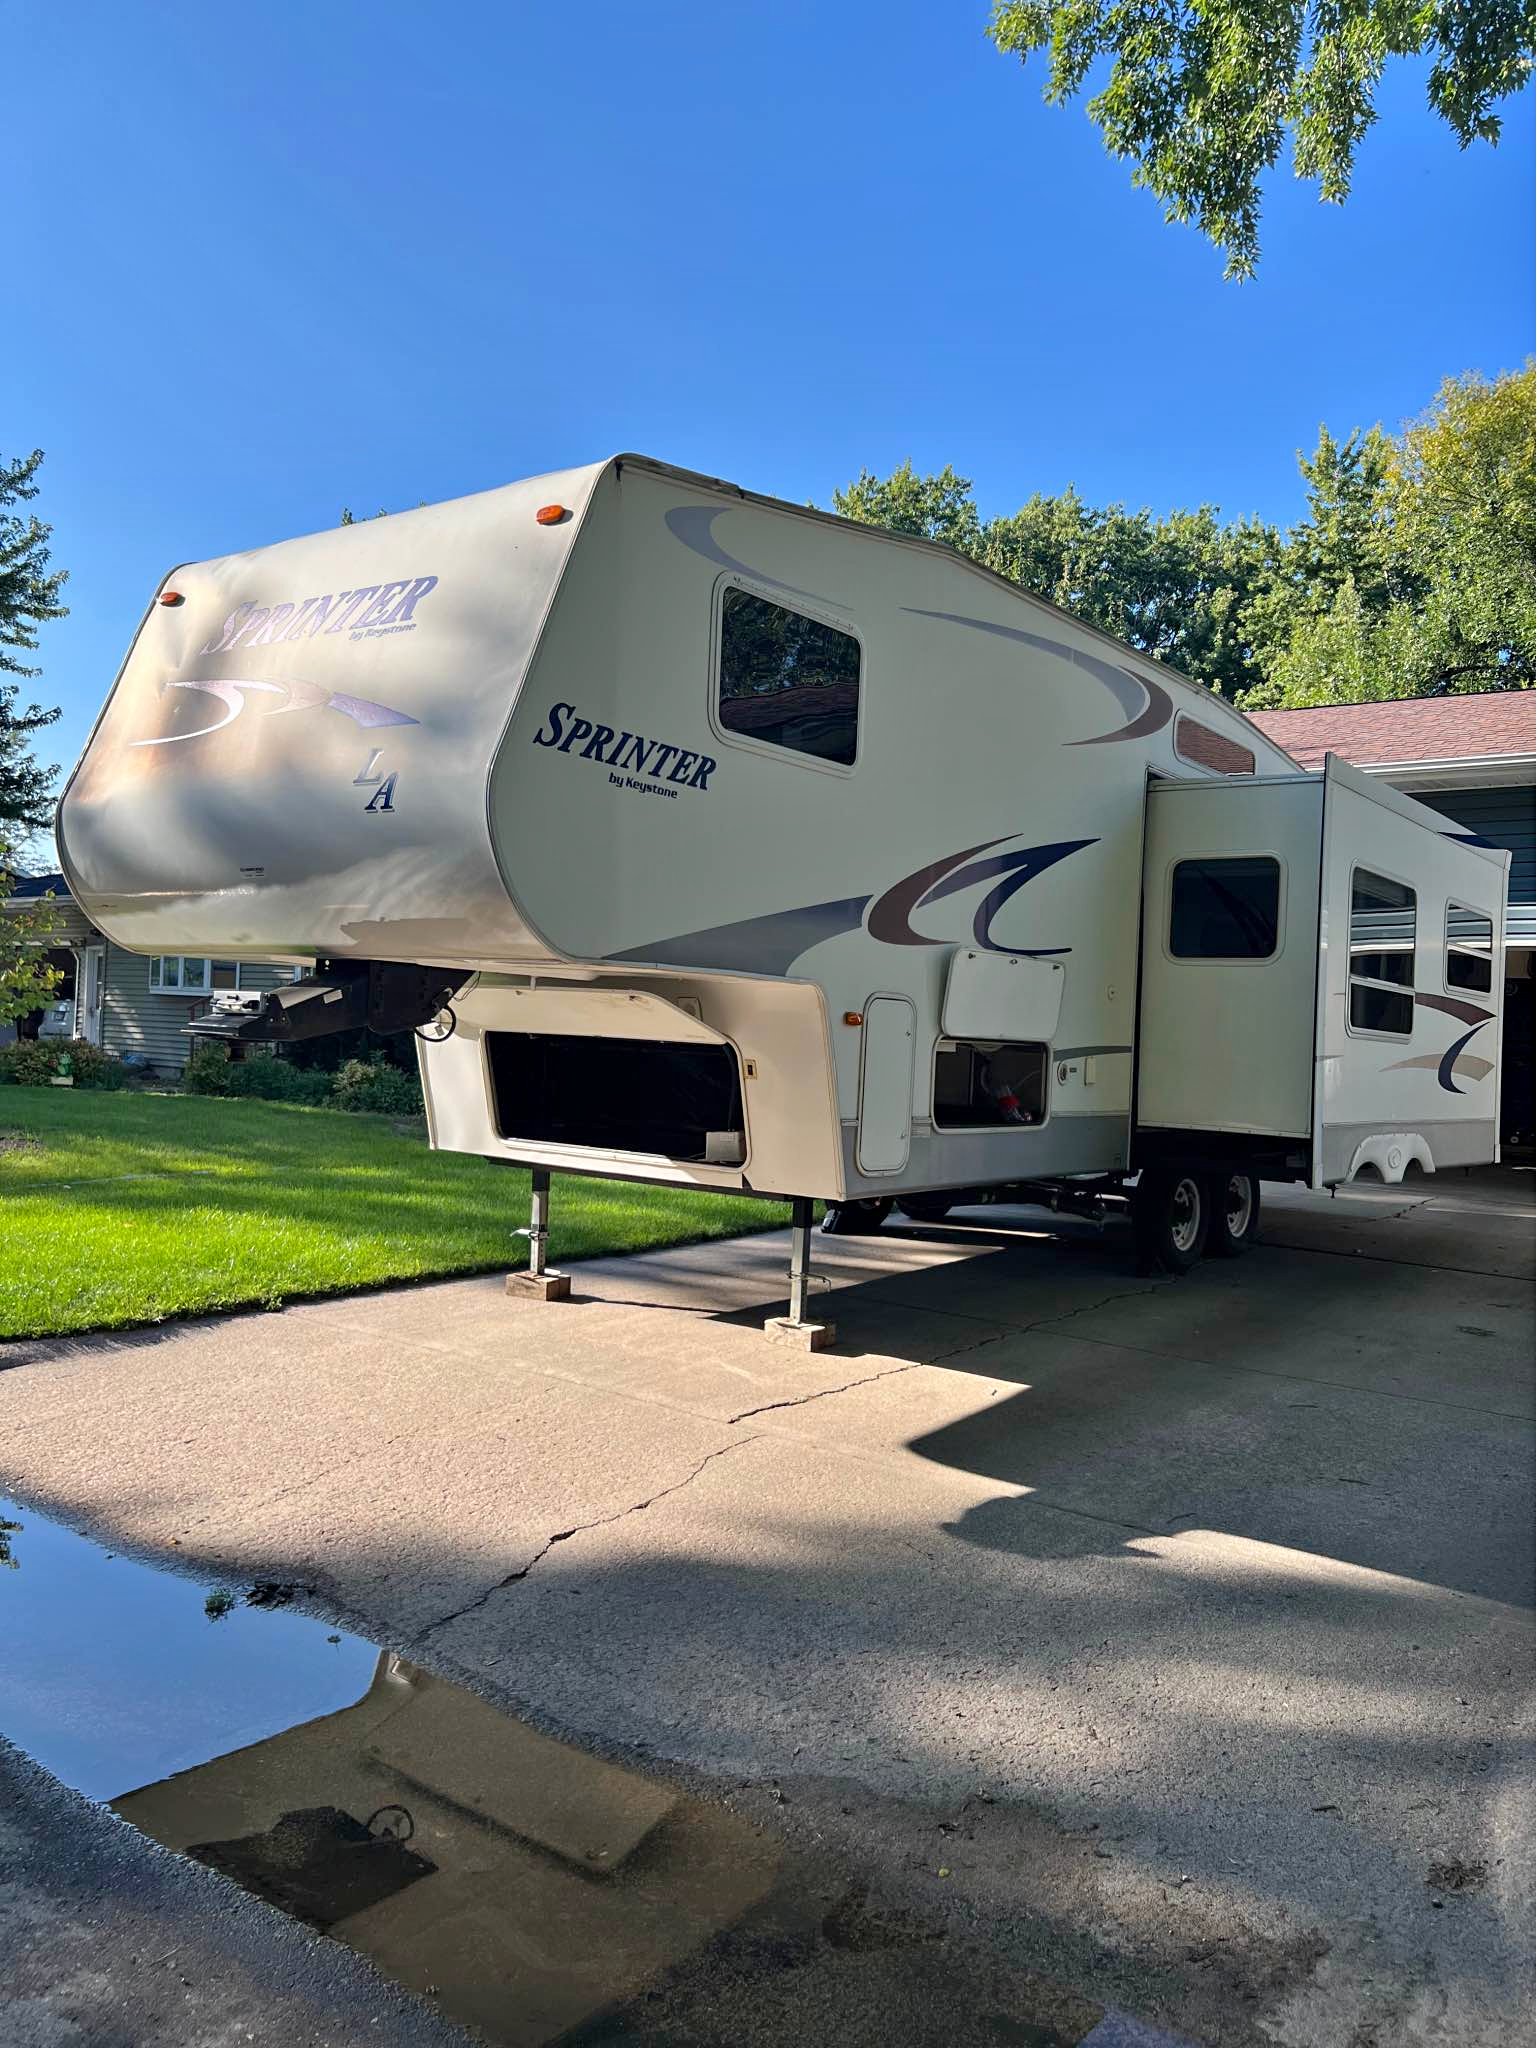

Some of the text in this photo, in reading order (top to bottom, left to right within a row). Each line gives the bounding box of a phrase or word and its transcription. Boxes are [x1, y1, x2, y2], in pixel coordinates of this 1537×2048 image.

[199, 575, 439, 656] SPRINTER
[364, 623, 417, 638] Keystone
[532, 702, 717, 790] SPRINTER
[608, 771, 678, 799] by Keystone
